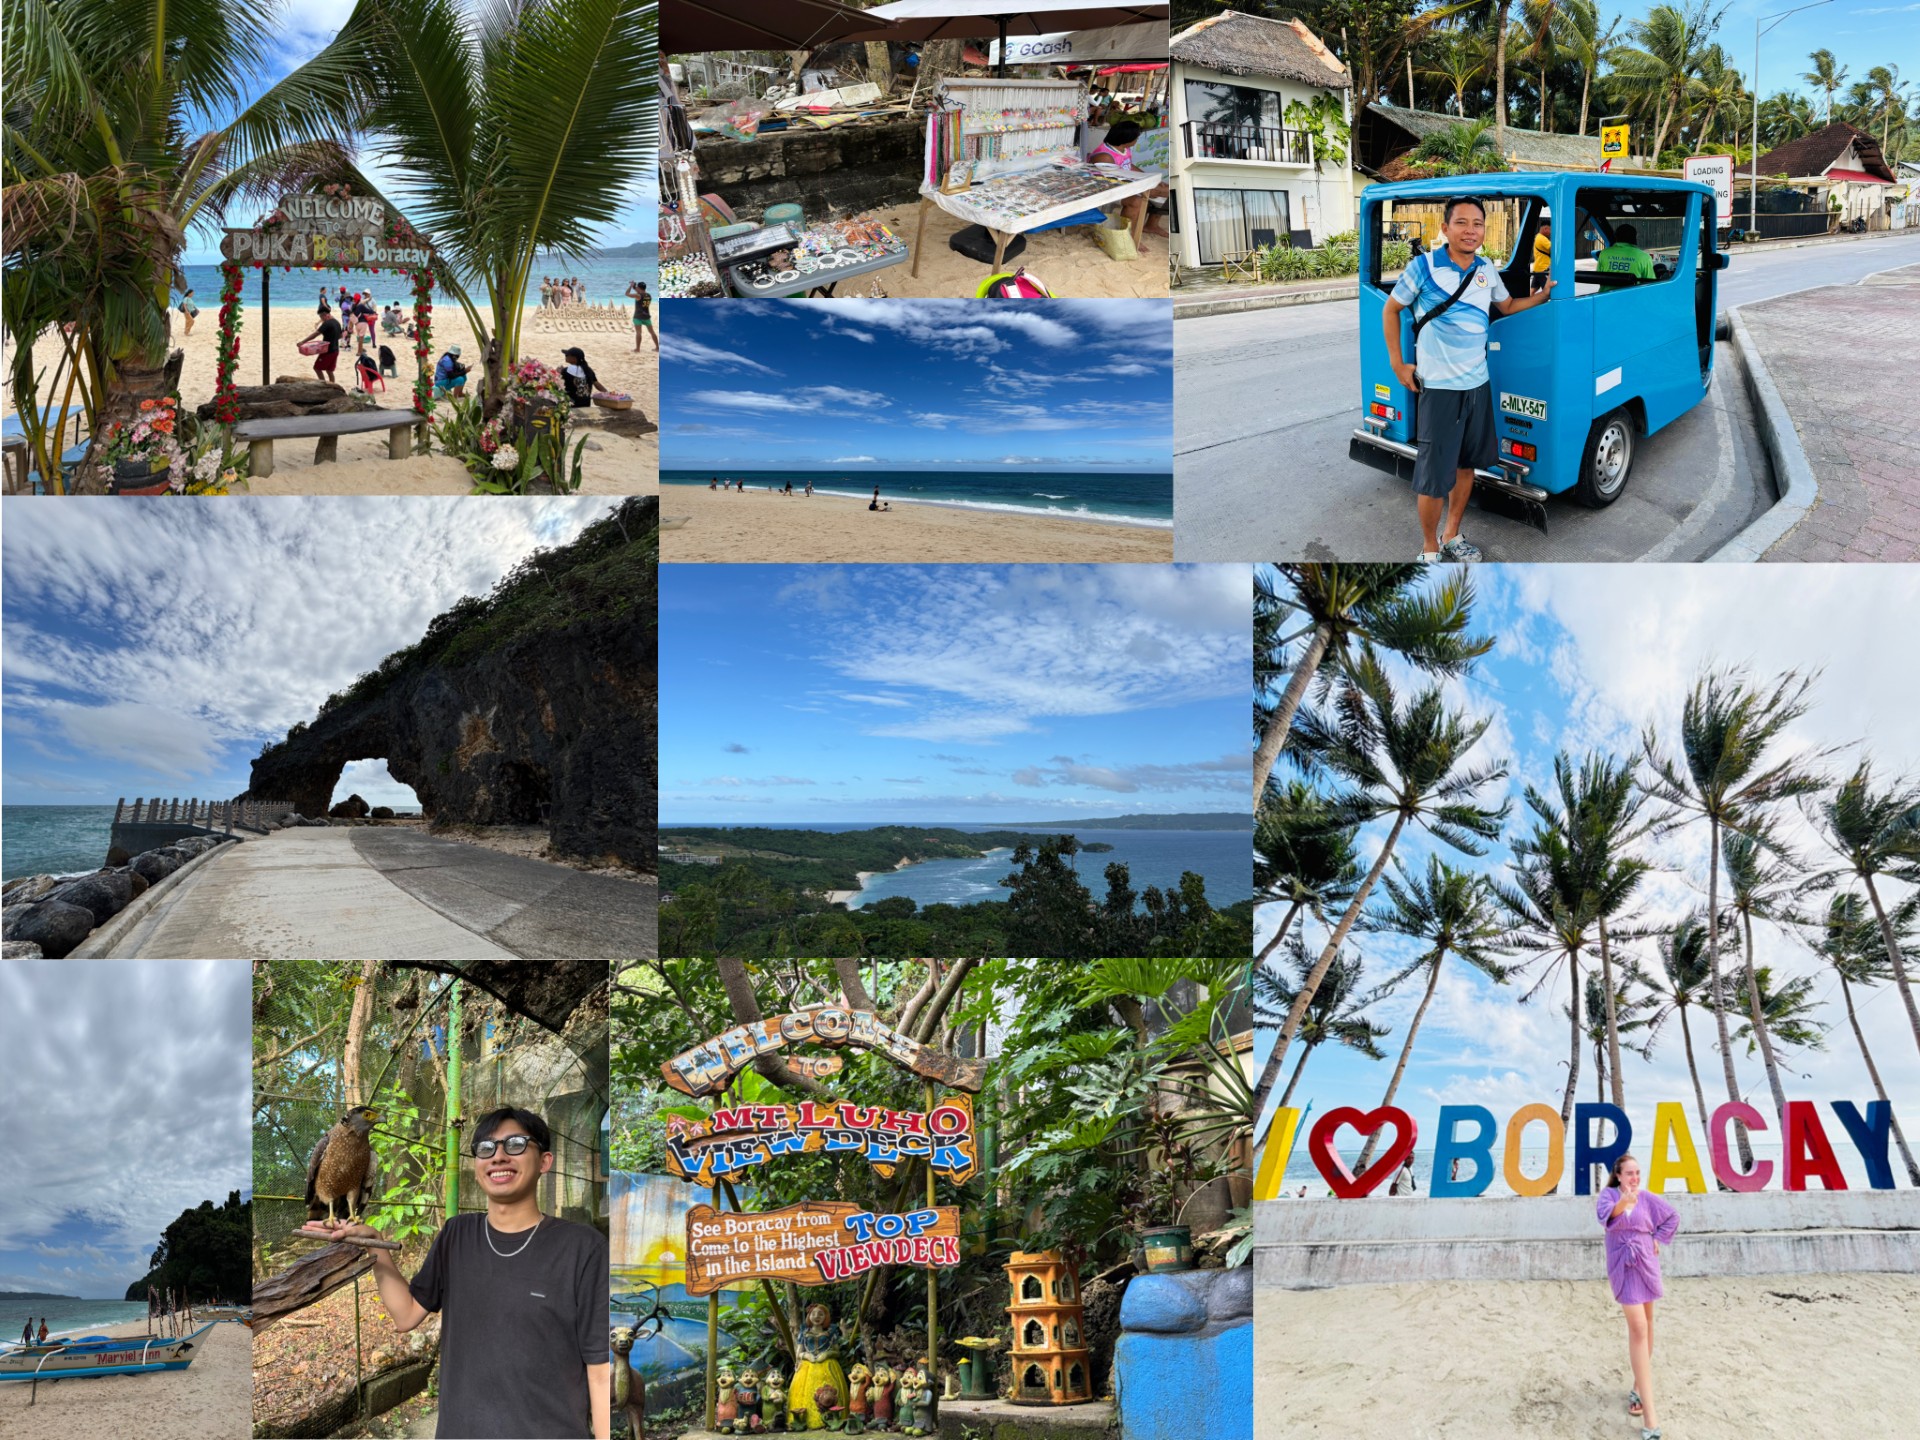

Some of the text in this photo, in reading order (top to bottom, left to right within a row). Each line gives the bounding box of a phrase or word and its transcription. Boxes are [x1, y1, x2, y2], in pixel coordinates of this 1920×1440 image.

[1020, 38, 1072, 56] GCash
[1693, 166, 1724, 176] LOADING
[282, 199, 385, 226] WELCOME
[323, 221, 341, 233] TO
[232, 232, 431, 266] PUKA Beach Boracay
[1608, 261, 1631, 272] 1668
[671, 1009, 920, 1091] WELCOME
[799, 1056, 834, 1078] TO
[711, 1100, 969, 1136] MT. LUHO
[1429, 1100, 1896, 1198] BORACAY
[691, 1211, 832, 1239] See Boracay from
[845, 1209, 939, 1242] TOP
[691, 1229, 841, 1257] Come to the Highest
[705, 1258, 723, 1278] in
[724, 1256, 751, 1275] the
